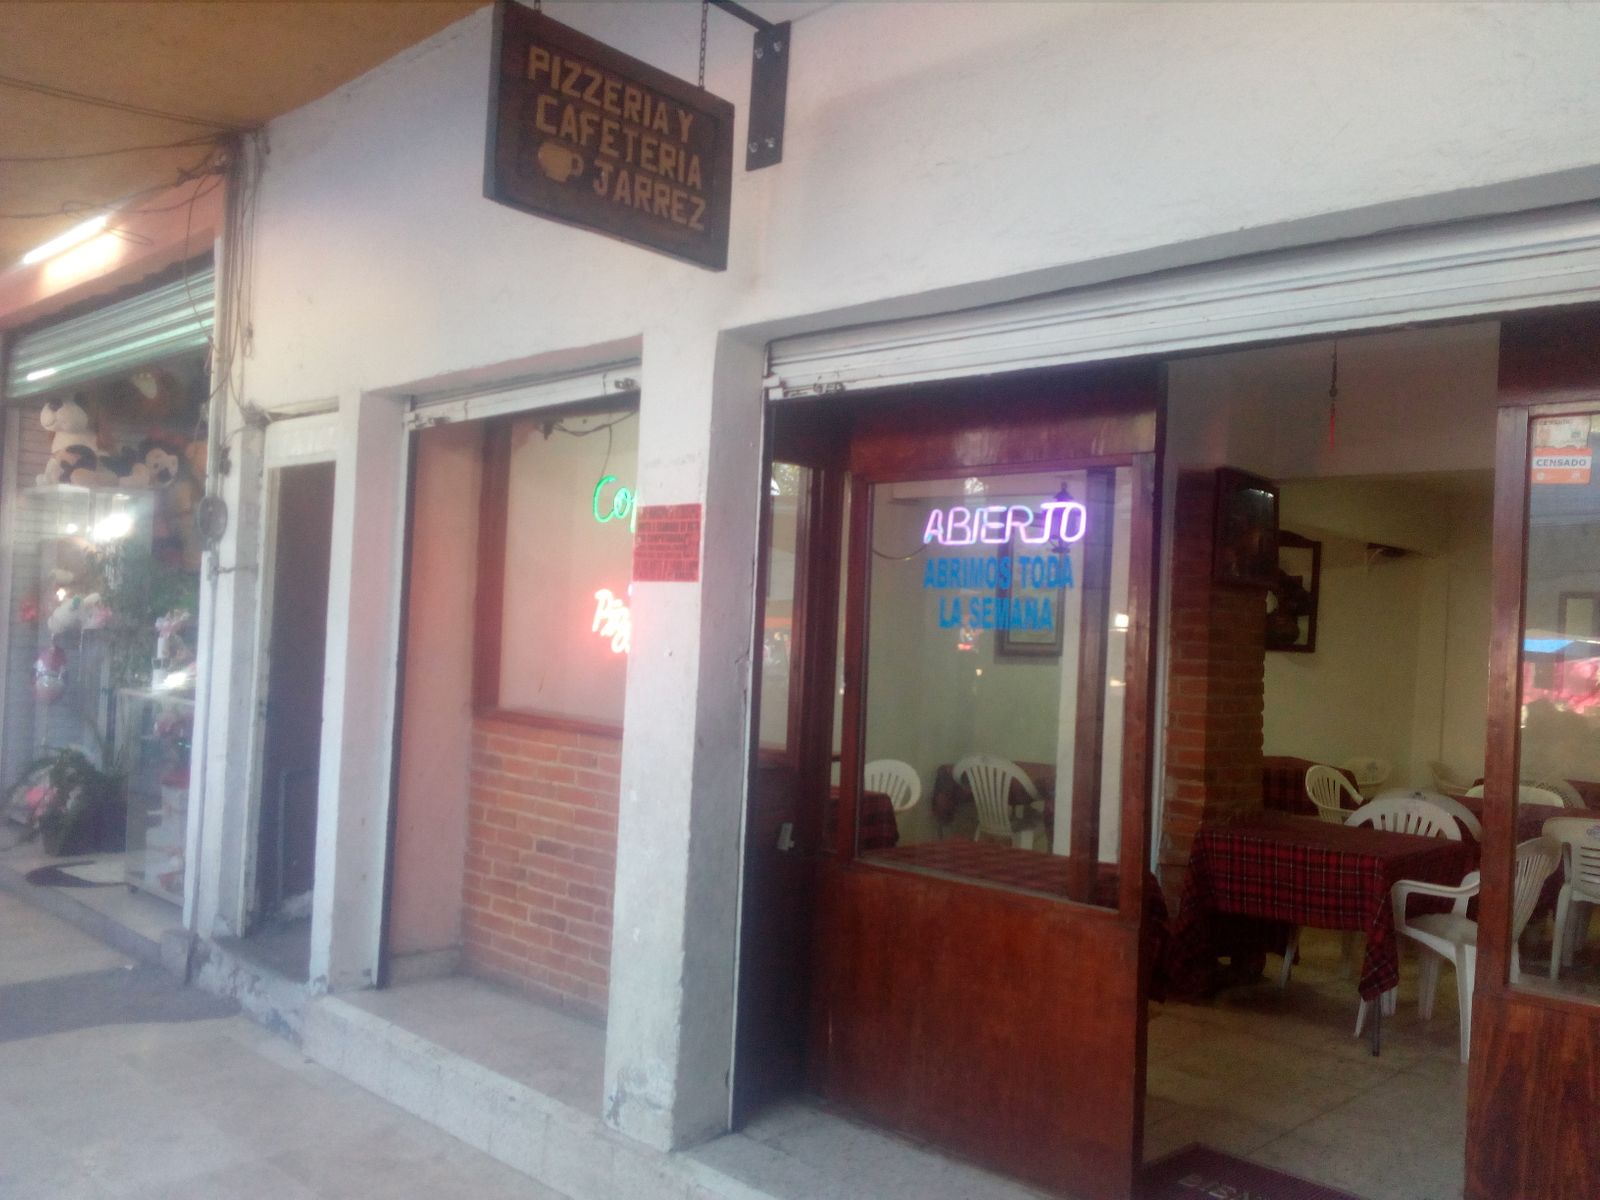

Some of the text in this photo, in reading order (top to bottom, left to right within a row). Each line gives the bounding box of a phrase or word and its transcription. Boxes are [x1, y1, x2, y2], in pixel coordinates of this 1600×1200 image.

[528, 46, 694, 143] PIZZERIA Y
[536, 94, 702, 190] CAFETERIA
[592, 158, 705, 230] JARREZ
[1536, 458, 1587, 467] CENSADO
[923, 501, 1087, 545] ABIERTO
[923, 555, 1073, 589] ABRIMOS TODA
[938, 596, 1054, 630] LA SEMANA
